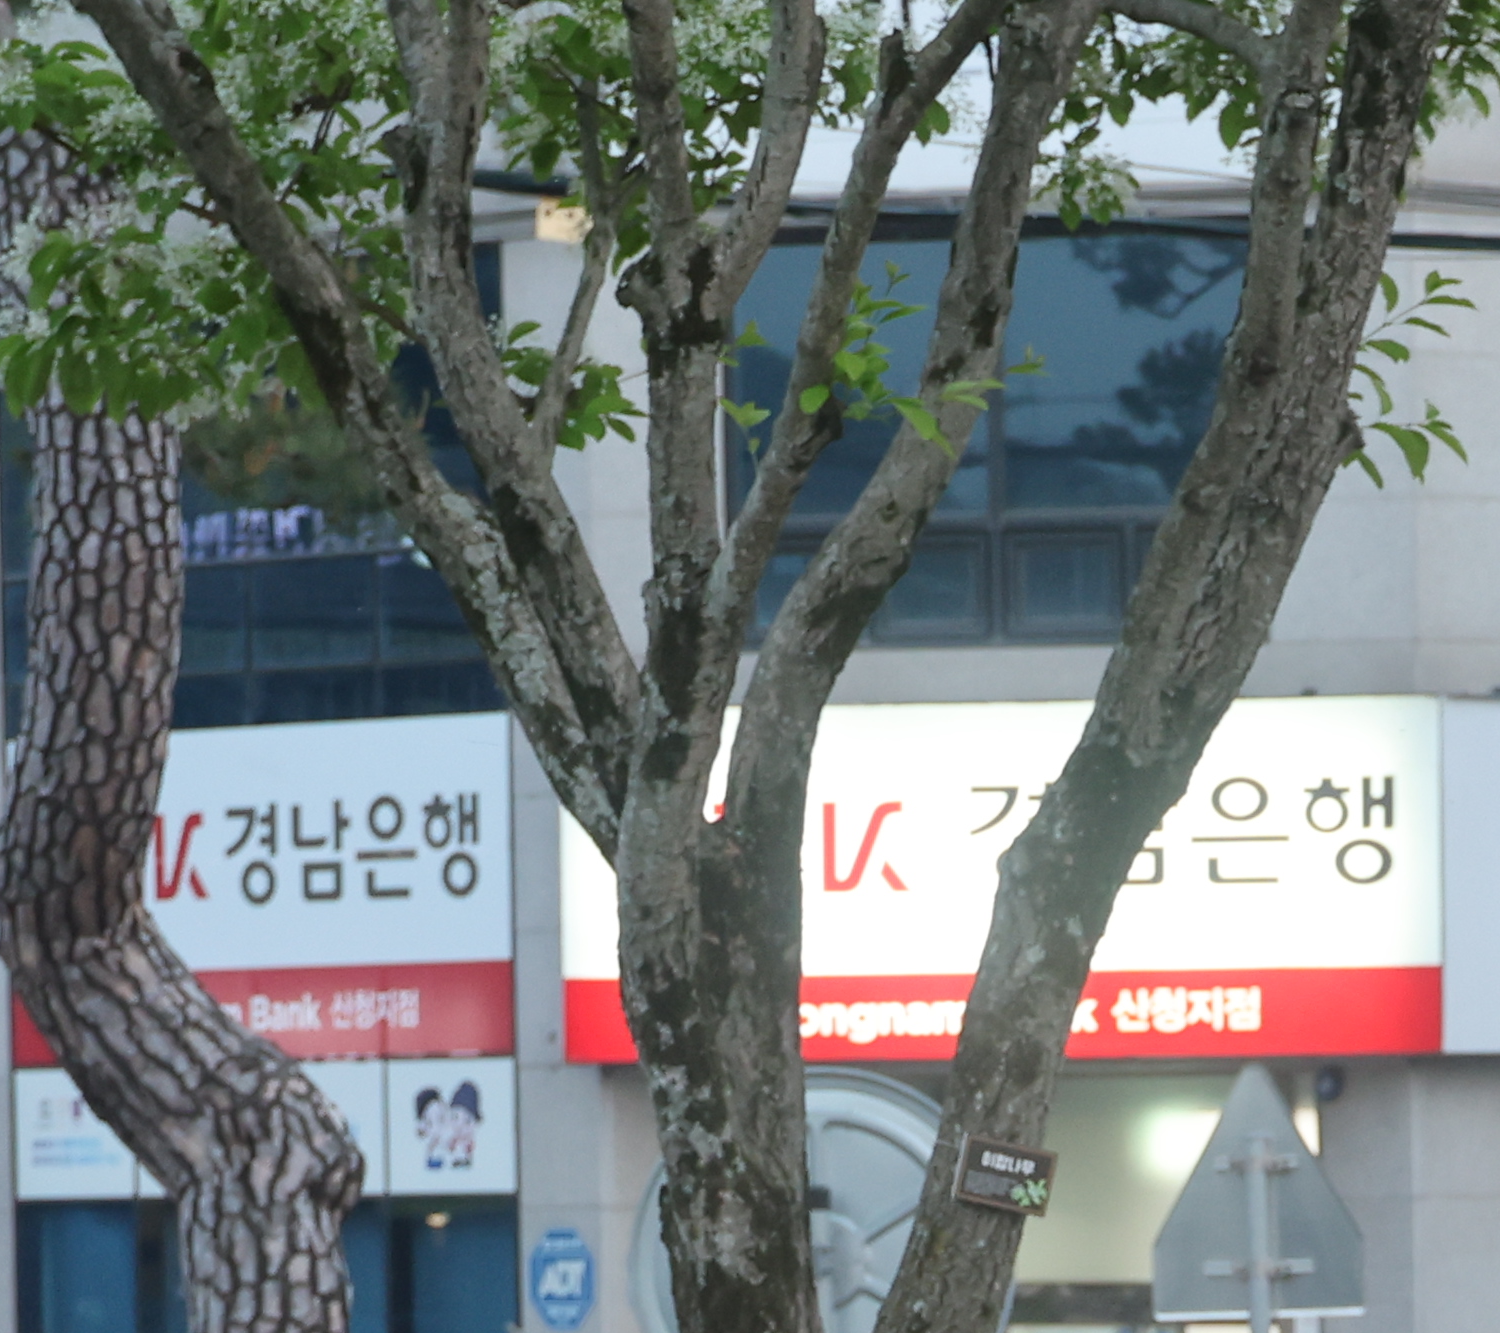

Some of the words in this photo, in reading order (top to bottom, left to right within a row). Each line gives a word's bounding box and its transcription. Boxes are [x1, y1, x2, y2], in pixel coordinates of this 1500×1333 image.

[225, 791, 480, 904] 경남은행
[970, 775, 1394, 885] 은행
[250, 991, 322, 1032] Bank
[329, 987, 420, 1029] 산청지점
[799, 999, 966, 1044] ongnam
[1111, 985, 1262, 1033] 산청지점
